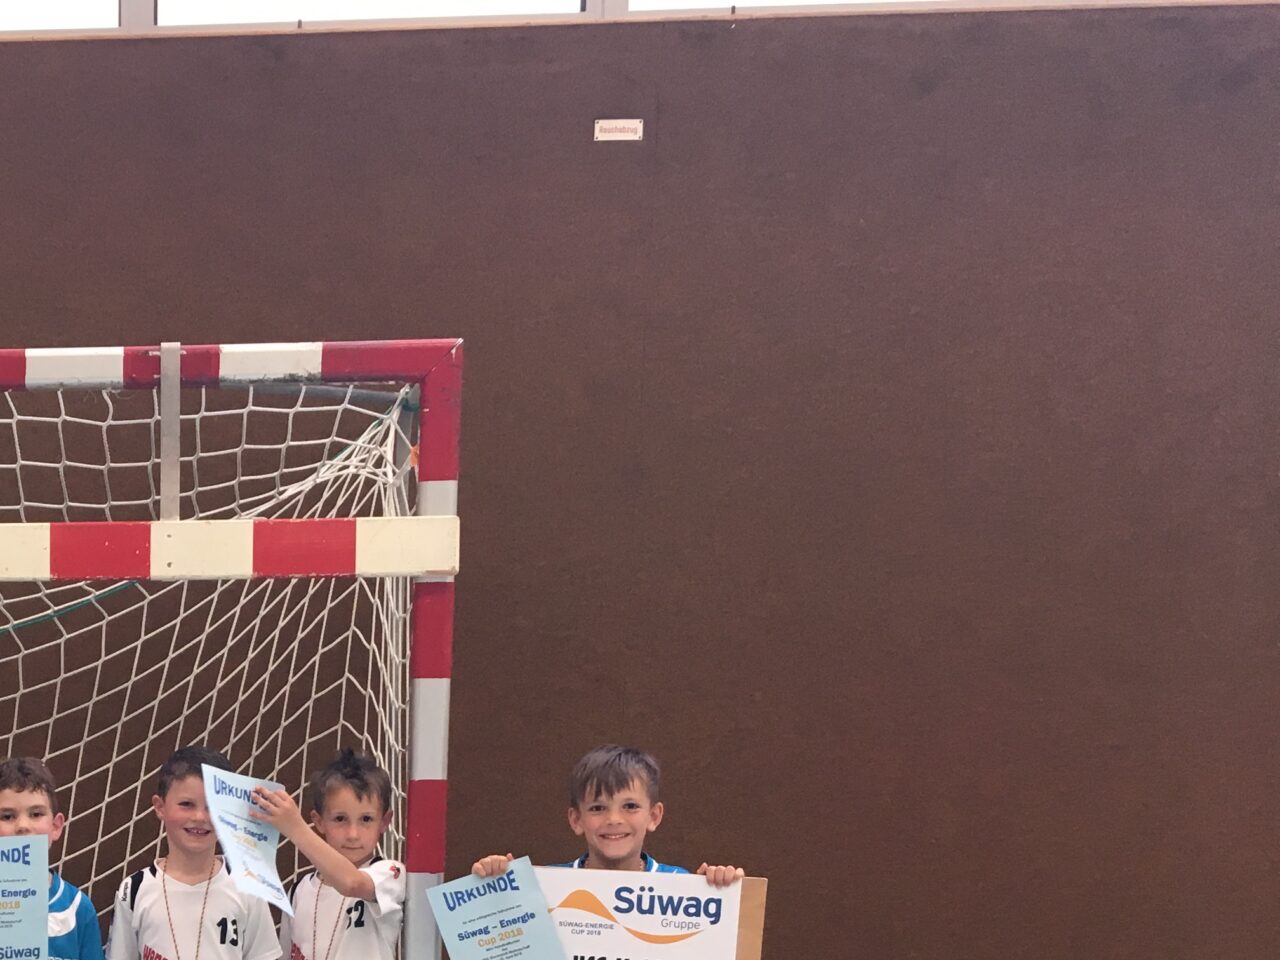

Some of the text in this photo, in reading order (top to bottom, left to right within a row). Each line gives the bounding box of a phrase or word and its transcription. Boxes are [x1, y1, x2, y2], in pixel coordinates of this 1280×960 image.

[1, 888, 37, 899] Energie
[443, 868, 520, 912] URKUNDE
[614, 886, 722, 925] Süwag
[216, 917, 239, 947] 13
[457, 924, 492, 942] Süwag
[500, 911, 537, 929] Energie
[558, 920, 615, 930] SÜWAG-ENERGIE
[661, 918, 701, 931] Gruppe
[478, 930, 524, 947] Cup 2018
